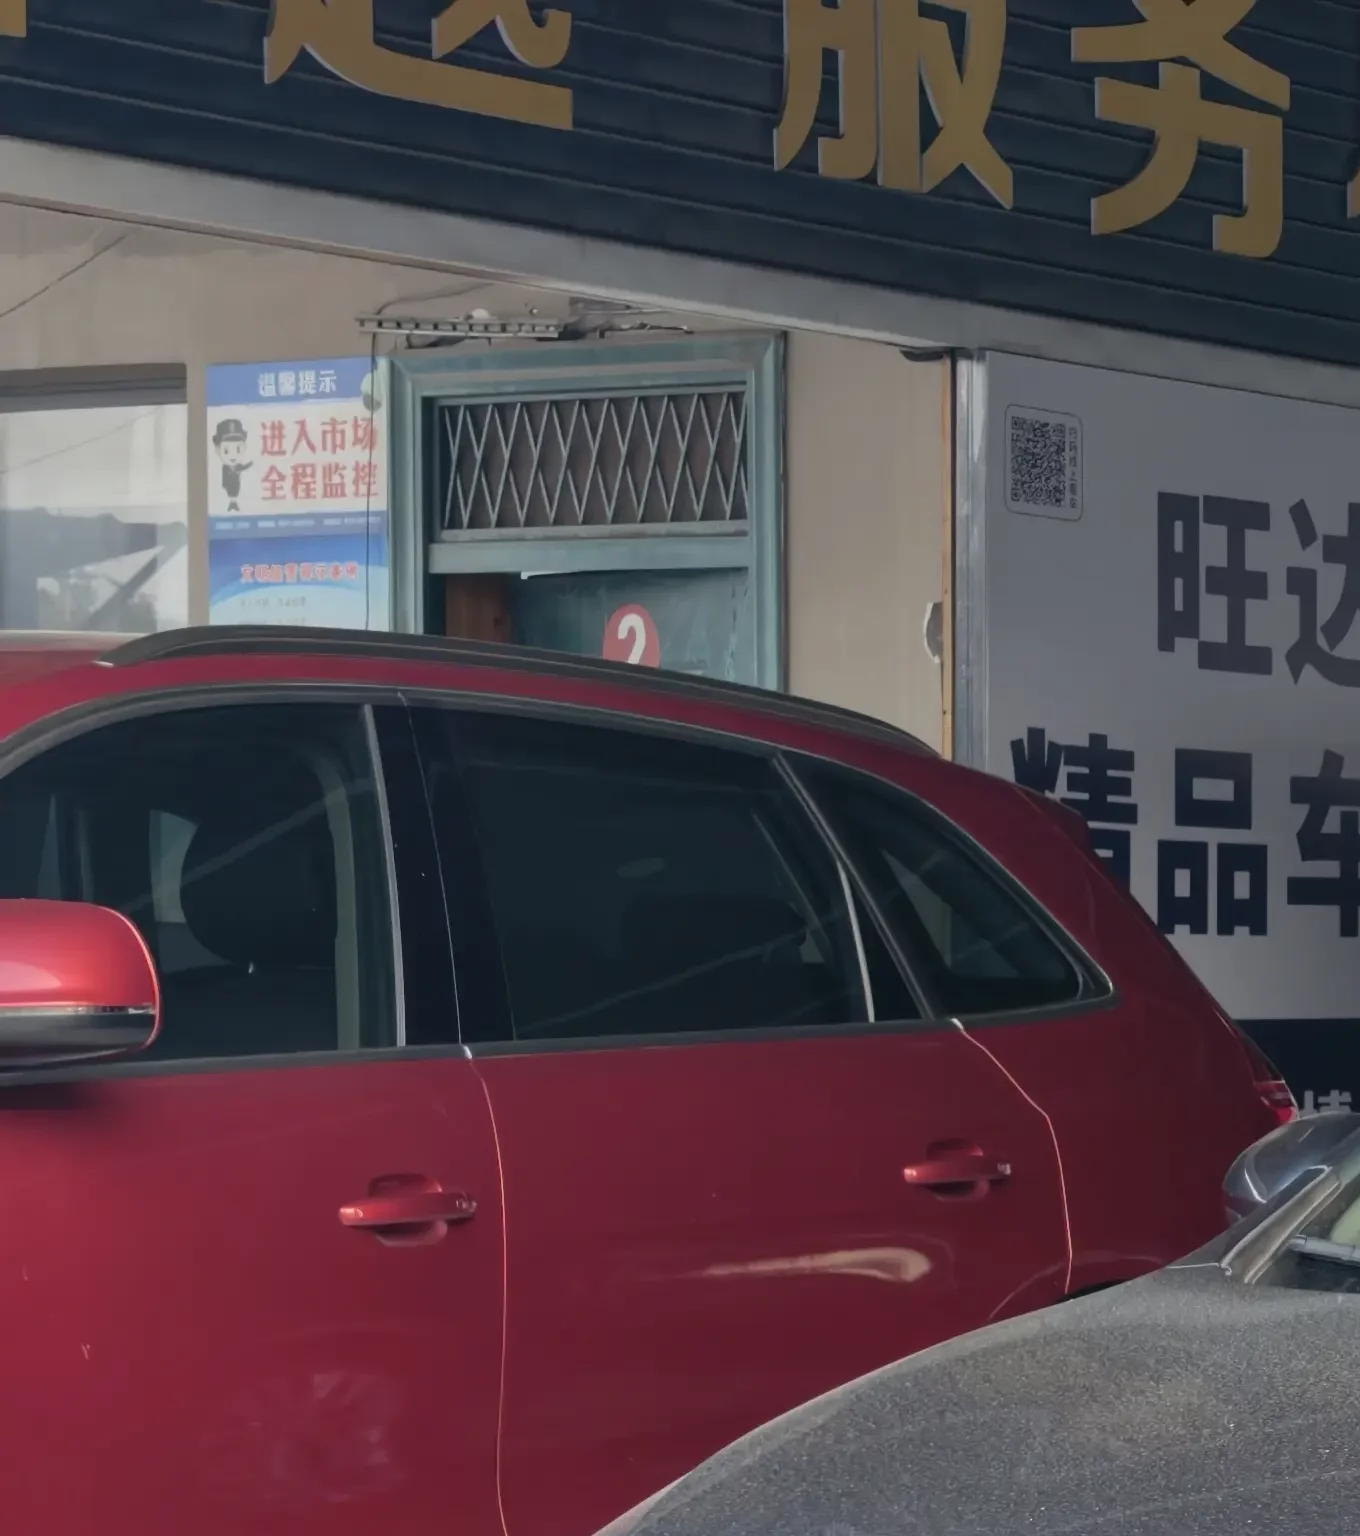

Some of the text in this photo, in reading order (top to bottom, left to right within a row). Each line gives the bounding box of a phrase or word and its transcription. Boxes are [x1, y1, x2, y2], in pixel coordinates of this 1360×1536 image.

[258, 370, 337, 396] 温馨提示
[260, 416, 379, 456] 进入市场
[260, 460, 380, 502] 全程监控
[617, 613, 646, 664] 2
